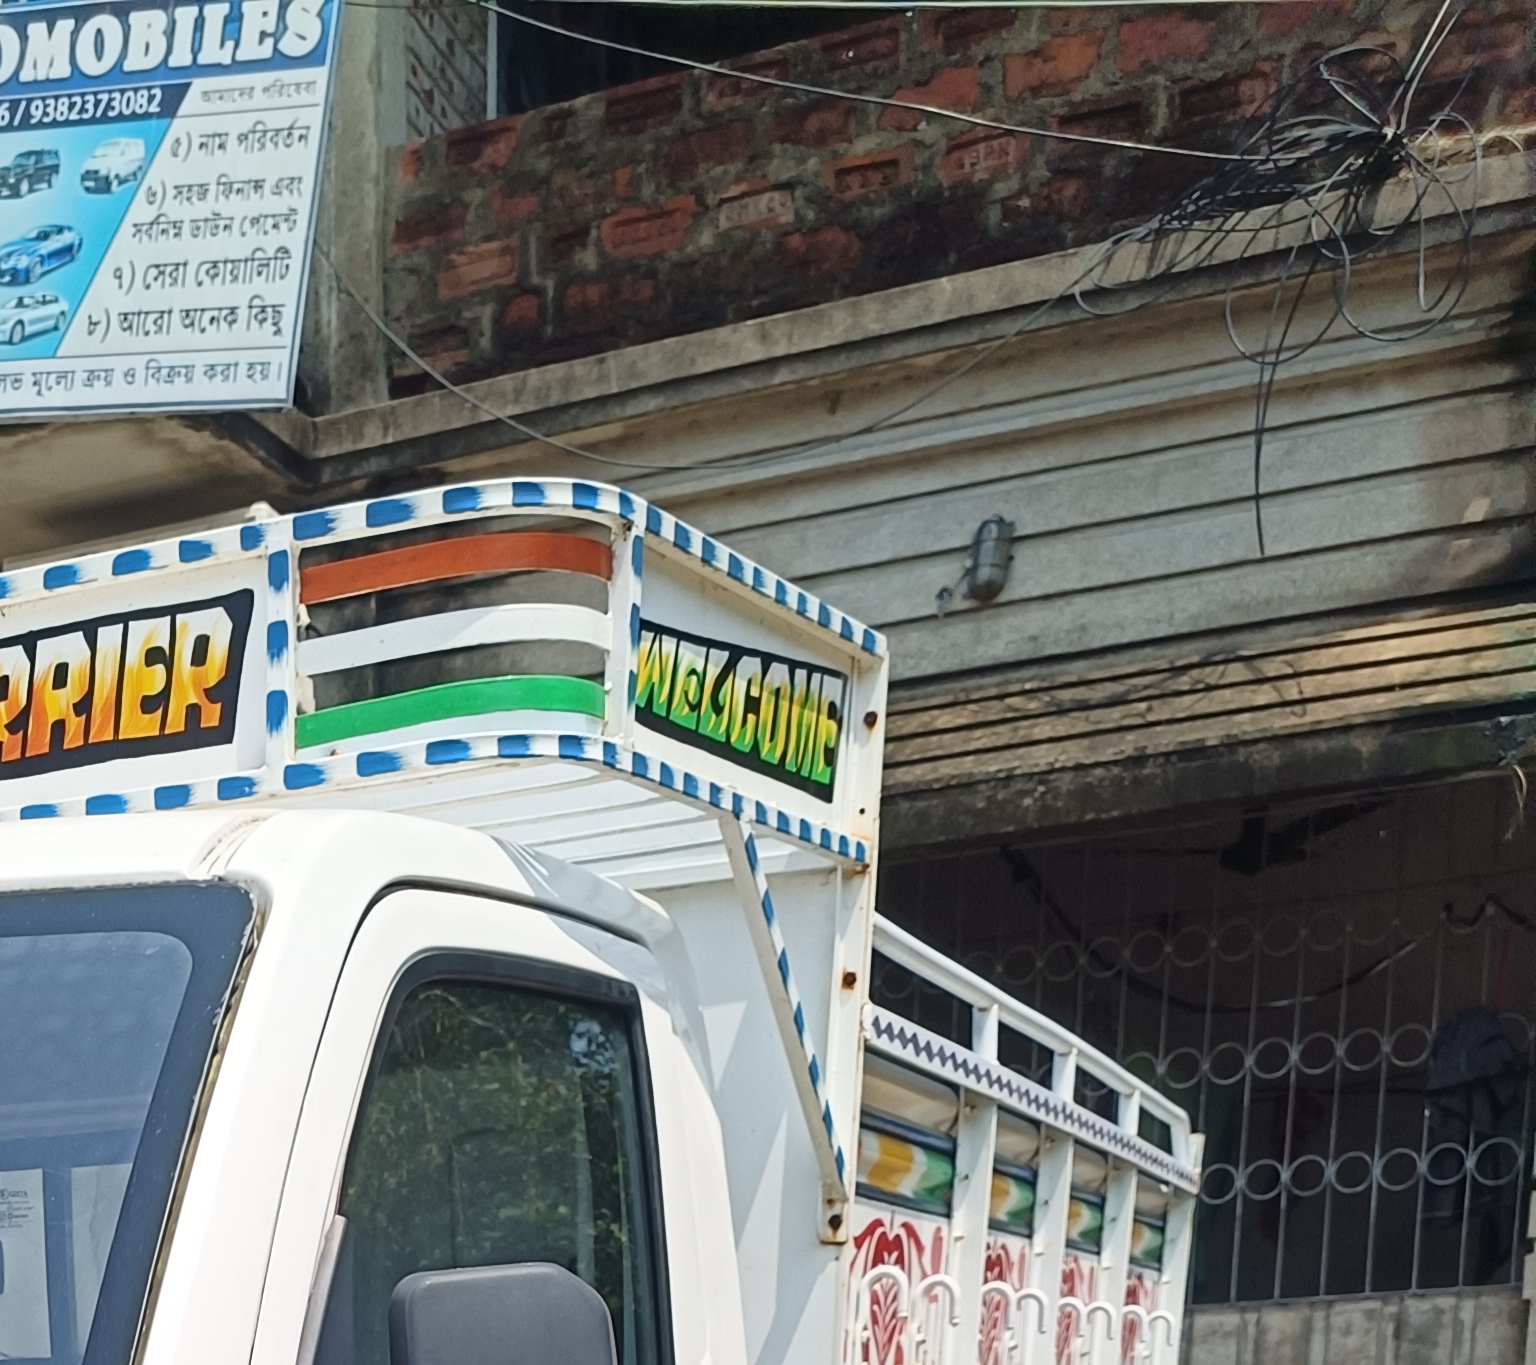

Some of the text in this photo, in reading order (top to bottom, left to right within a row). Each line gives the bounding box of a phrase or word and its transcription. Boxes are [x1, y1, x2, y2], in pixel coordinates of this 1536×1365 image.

[29, 87, 163, 124] 9382373082
[198, 133, 229, 156] নাম
[236, 117, 312, 155] পরিবর্তন
[172, 183, 210, 206] সহজ
[270, 176, 304, 200] এবং
[142, 259, 189, 290] সেরা
[194, 245, 292, 287] কোয়ালিটি
[117, 306, 173, 337] আরো
[180, 305, 240, 334] অনেক
[246, 294, 286, 338] কিছু
[123, 367, 136, 386] ও
[203, 362, 239, 384] করা
[635, 629, 845, 786] WELCOME
